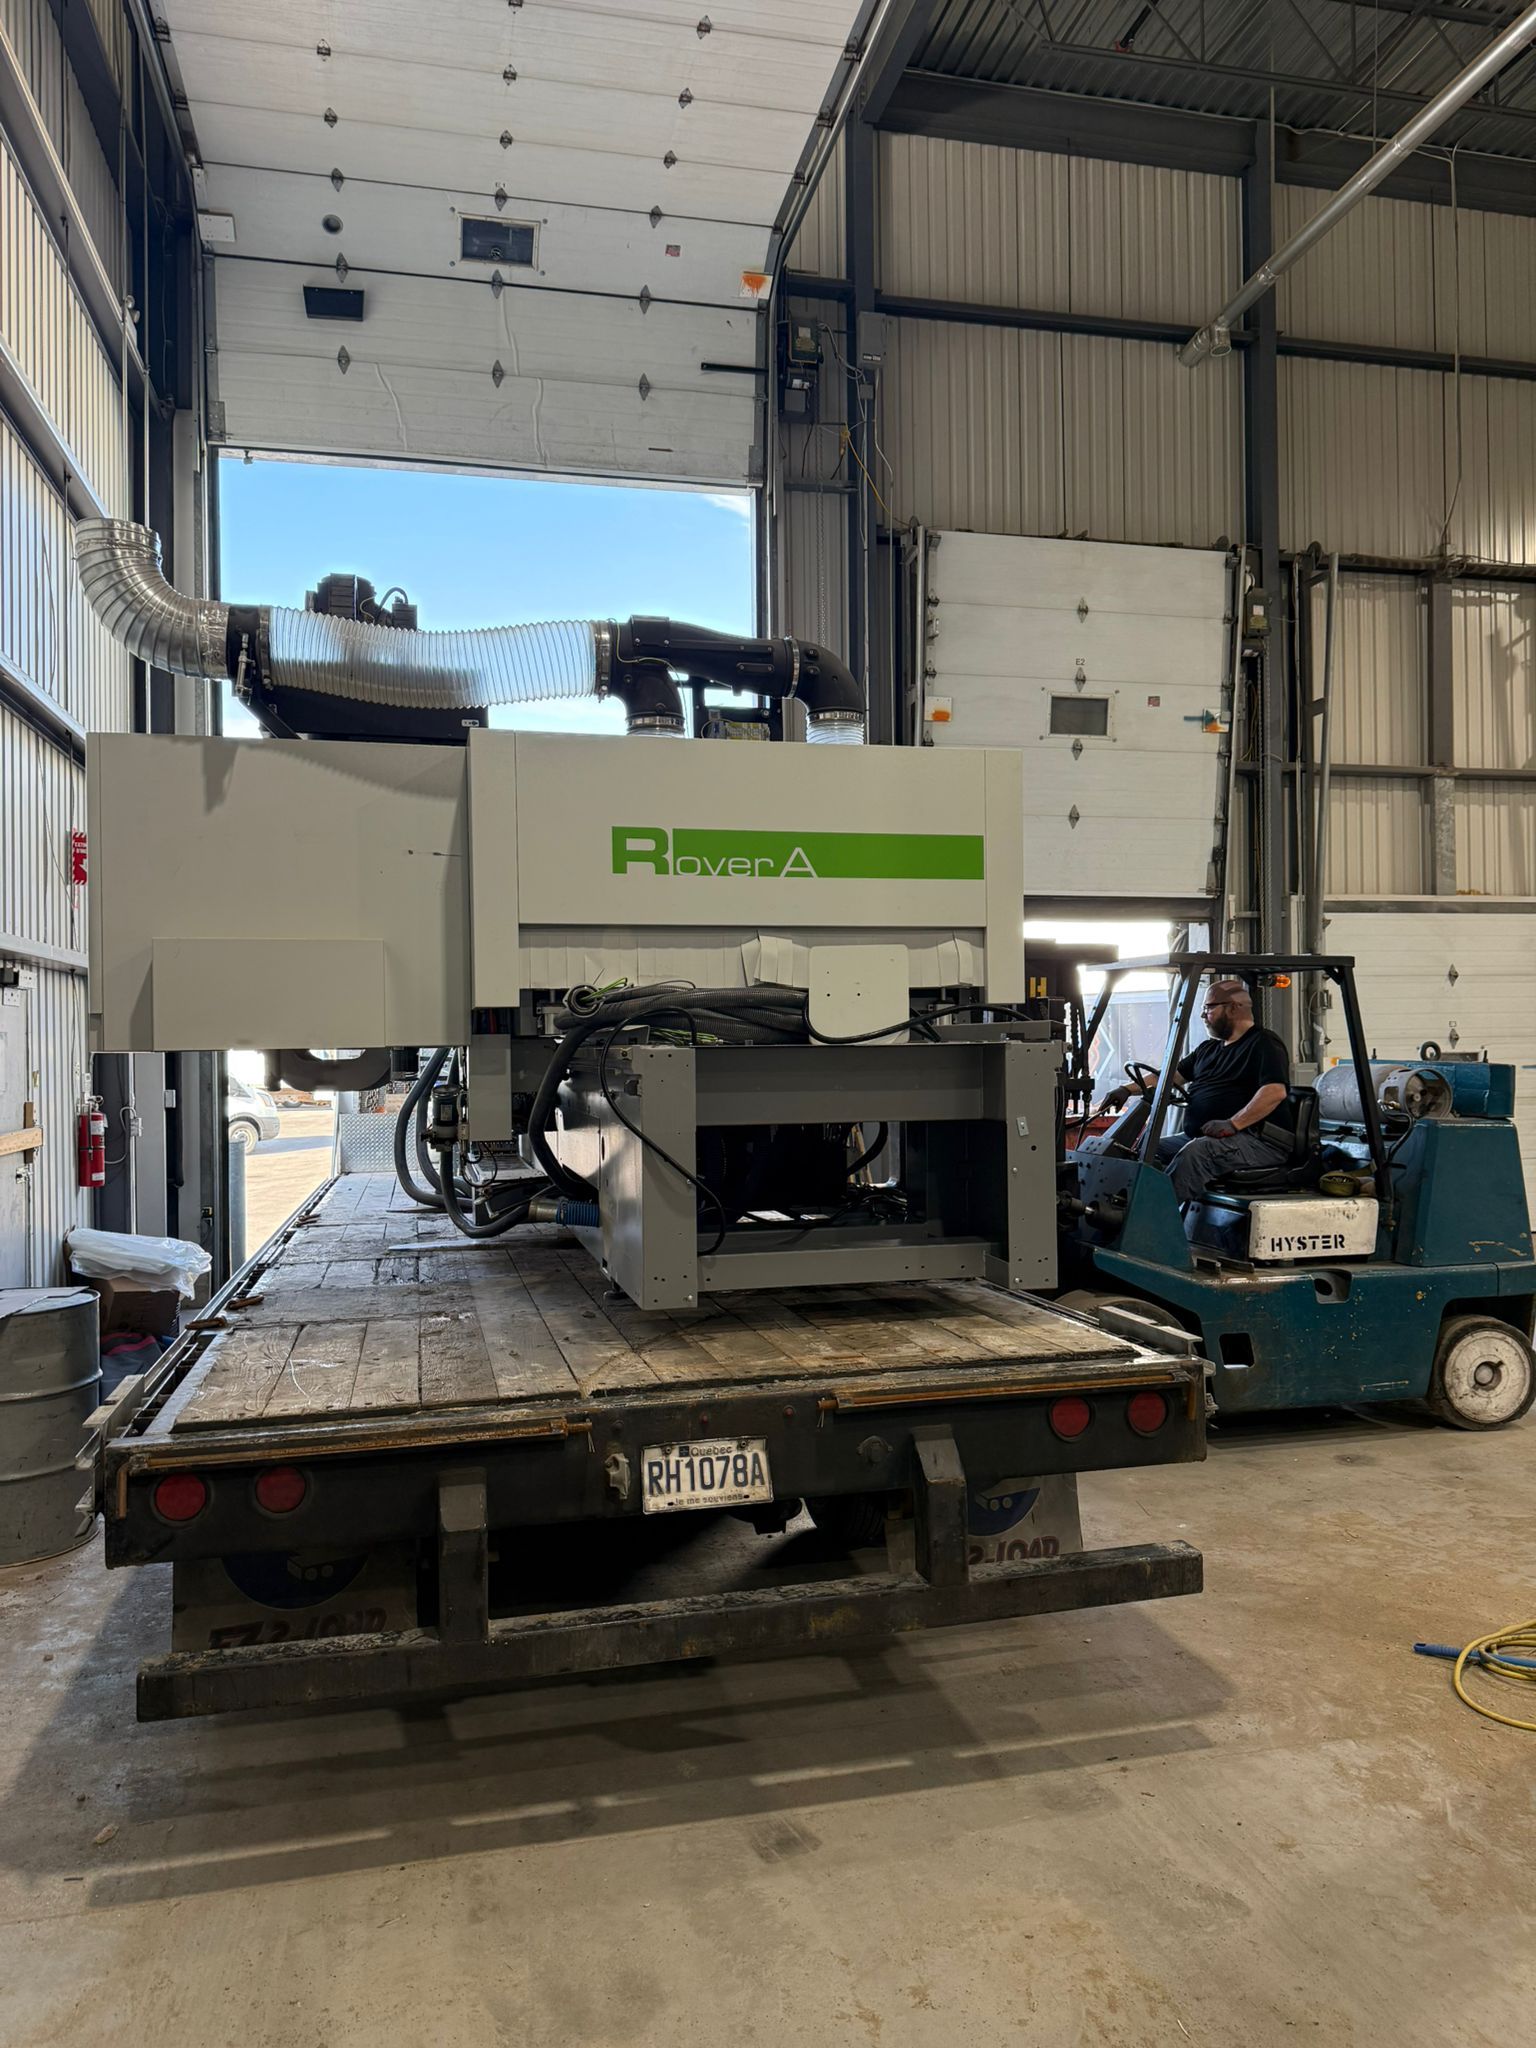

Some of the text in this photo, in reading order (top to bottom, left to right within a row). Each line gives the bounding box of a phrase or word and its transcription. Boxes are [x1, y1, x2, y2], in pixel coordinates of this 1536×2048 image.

[611, 826, 819, 878] Rover A
[1270, 1234, 1346, 1252] HYSTER
[647, 1452, 766, 1497] RH1078A
